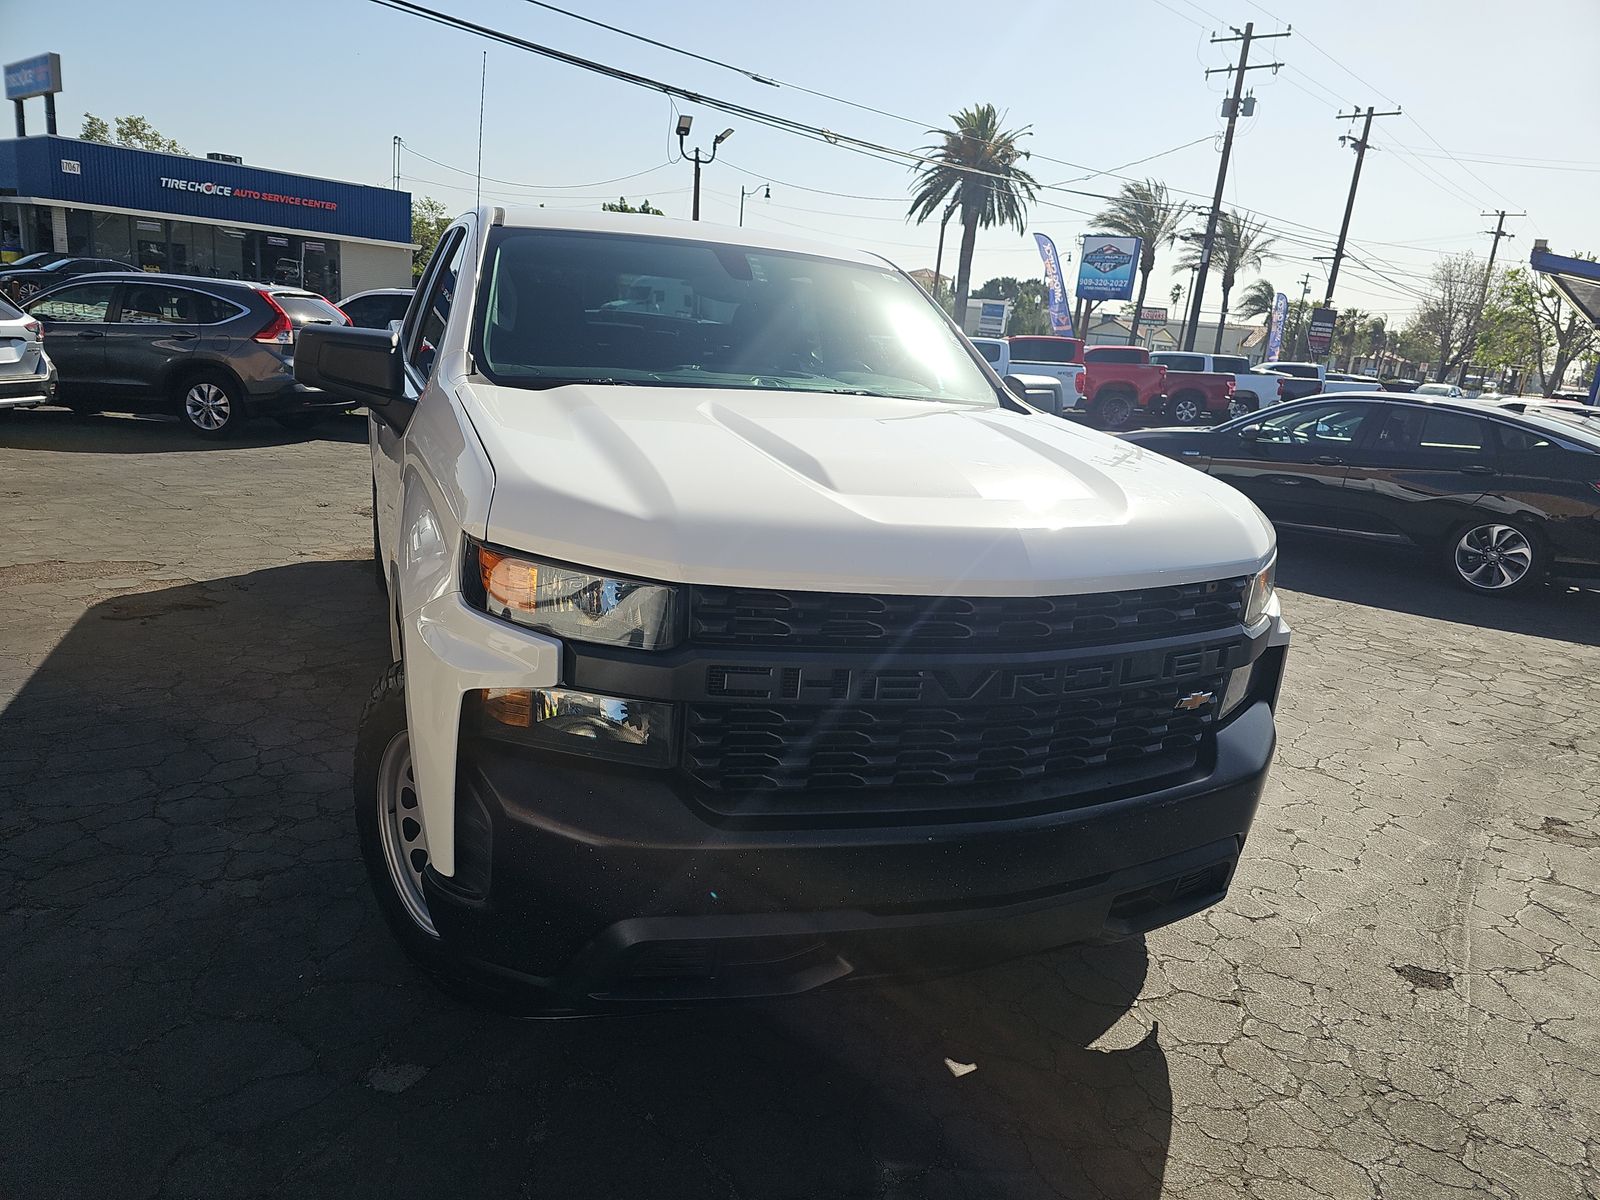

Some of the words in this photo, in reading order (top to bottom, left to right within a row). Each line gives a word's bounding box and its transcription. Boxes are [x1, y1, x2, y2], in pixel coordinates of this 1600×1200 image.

[233, 188, 260, 200] AUTO
[261, 192, 301, 206] SERVICE
[301, 198, 338, 211] CENTER
[704, 643, 1241, 702] CHEVROLET
